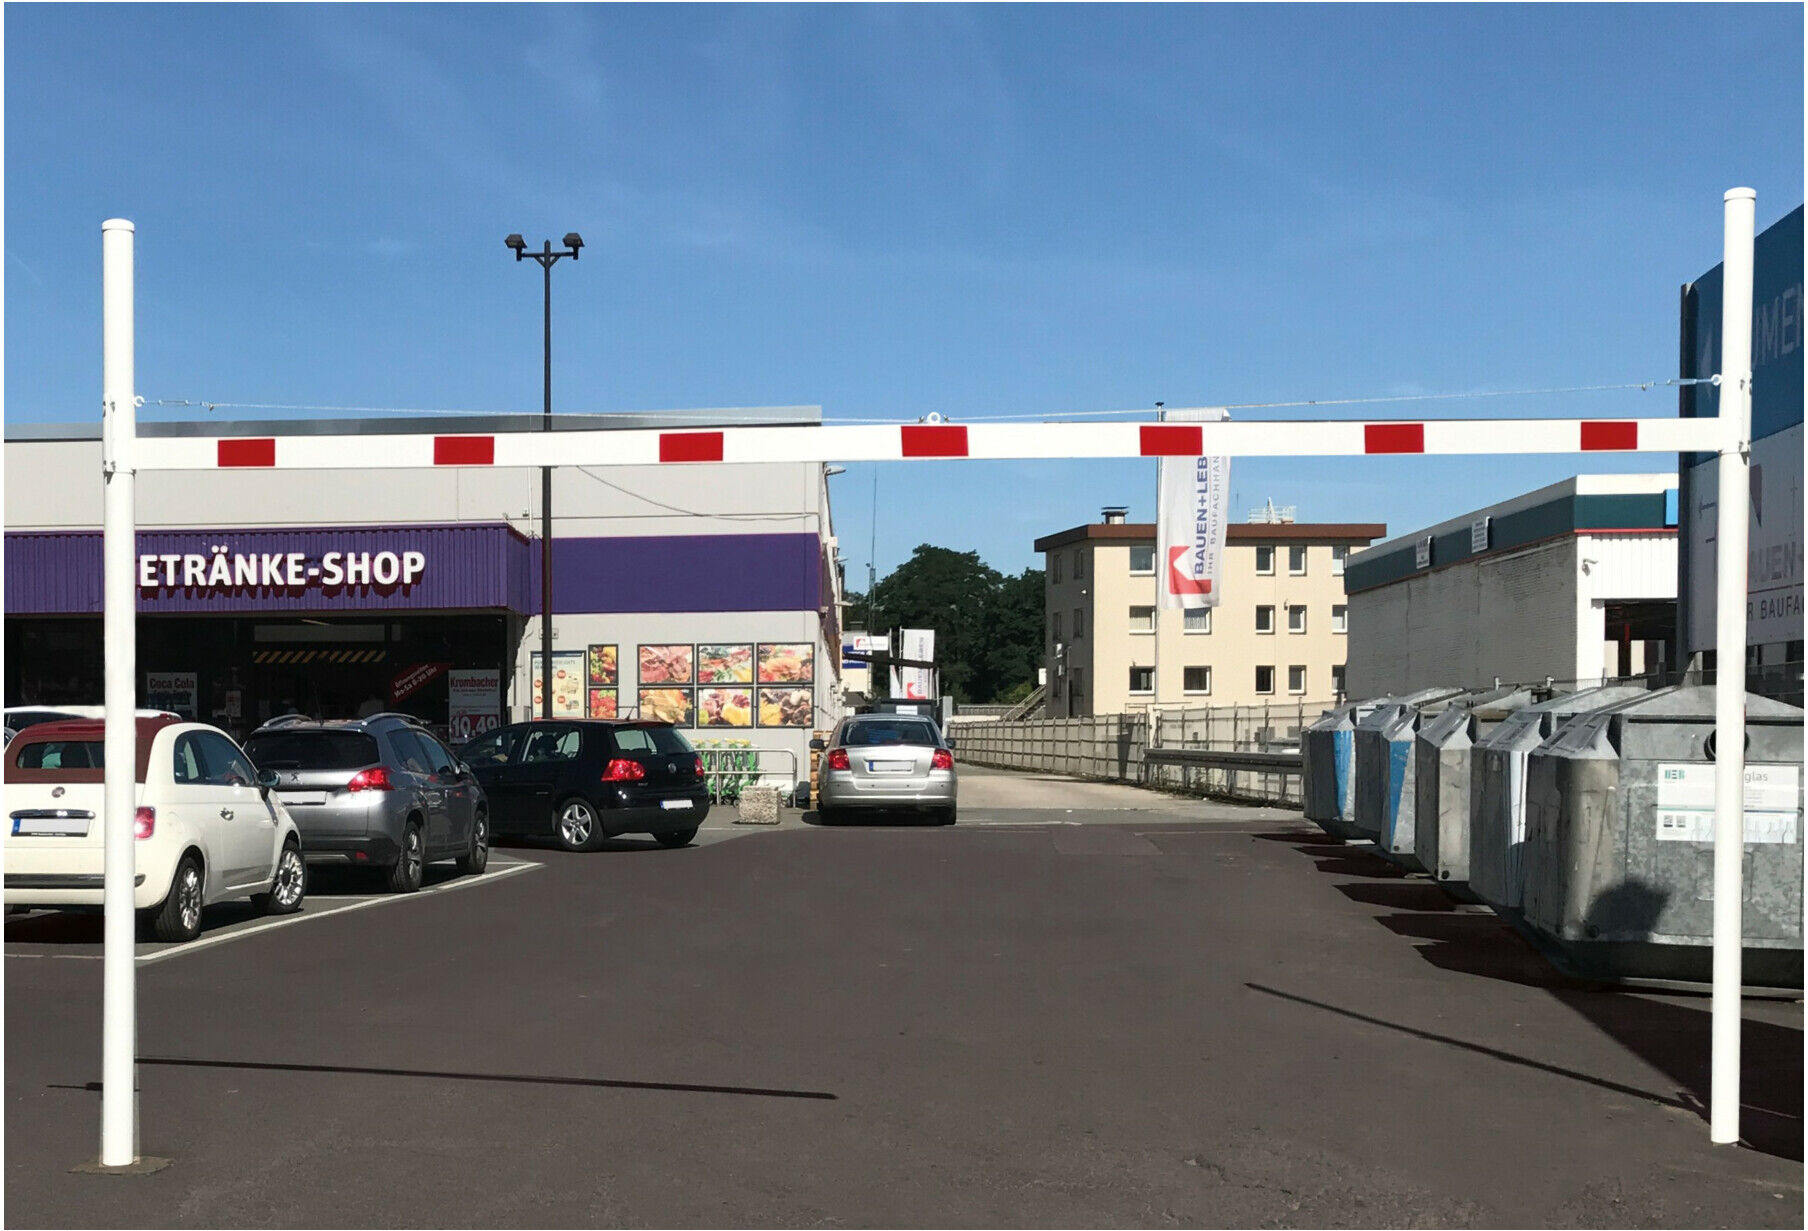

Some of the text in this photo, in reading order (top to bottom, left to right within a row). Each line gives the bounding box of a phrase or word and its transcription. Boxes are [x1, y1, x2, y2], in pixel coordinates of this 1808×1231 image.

[1194, 456, 1209, 575] BAUEN+LEB
[1207, 456, 1220, 575] IHR BAUFACHHAN
[139, 545, 426, 587] ETRÄNKE-SHOP
[150, 678, 172, 689] Coca
[450, 677, 498, 688] Krombacher
